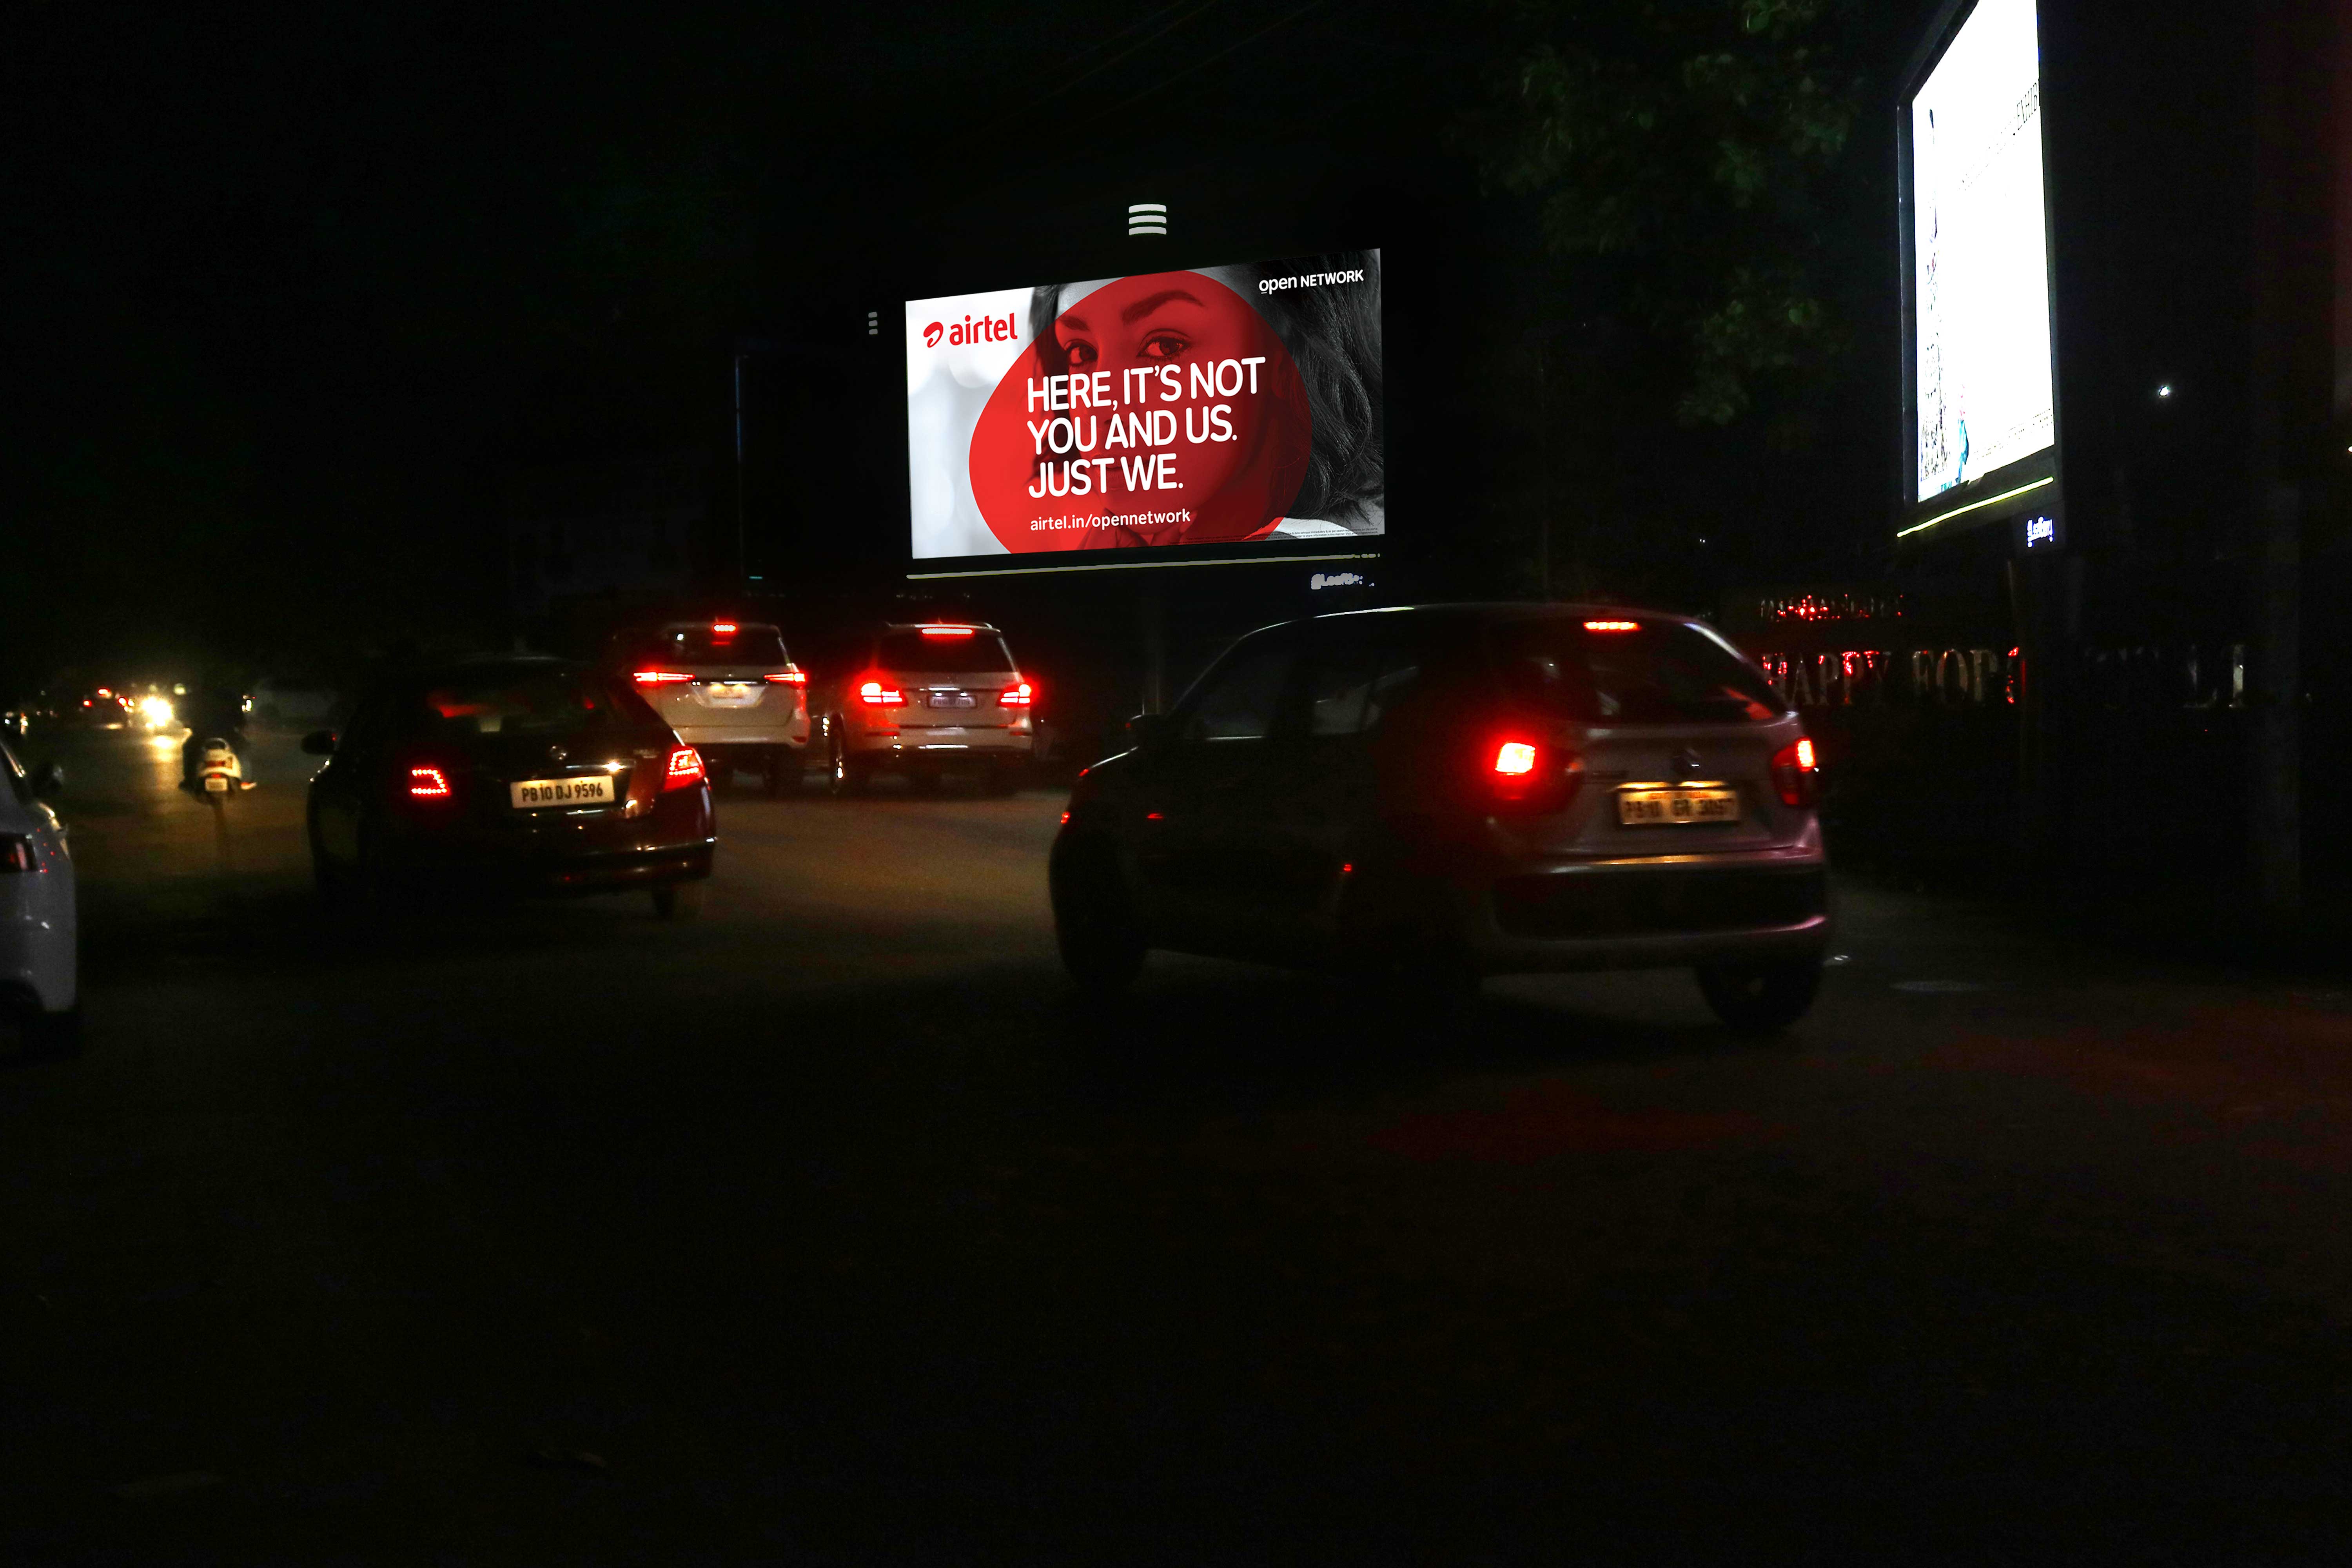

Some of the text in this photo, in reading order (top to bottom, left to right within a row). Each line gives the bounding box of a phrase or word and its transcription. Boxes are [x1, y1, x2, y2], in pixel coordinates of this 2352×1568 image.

[1259, 269, 1364, 295] open NETWORK
[949, 312, 1018, 346] airtel
[1027, 357, 1266, 413] HERE, IT'S NOT
[1027, 404, 1237, 455] YOU AND US.
[1028, 453, 1183, 498] JUST WE.
[1031, 508, 1191, 531] airtel.in/opennetwork
[521, 782, 603, 802] PB10 DJ 9596
